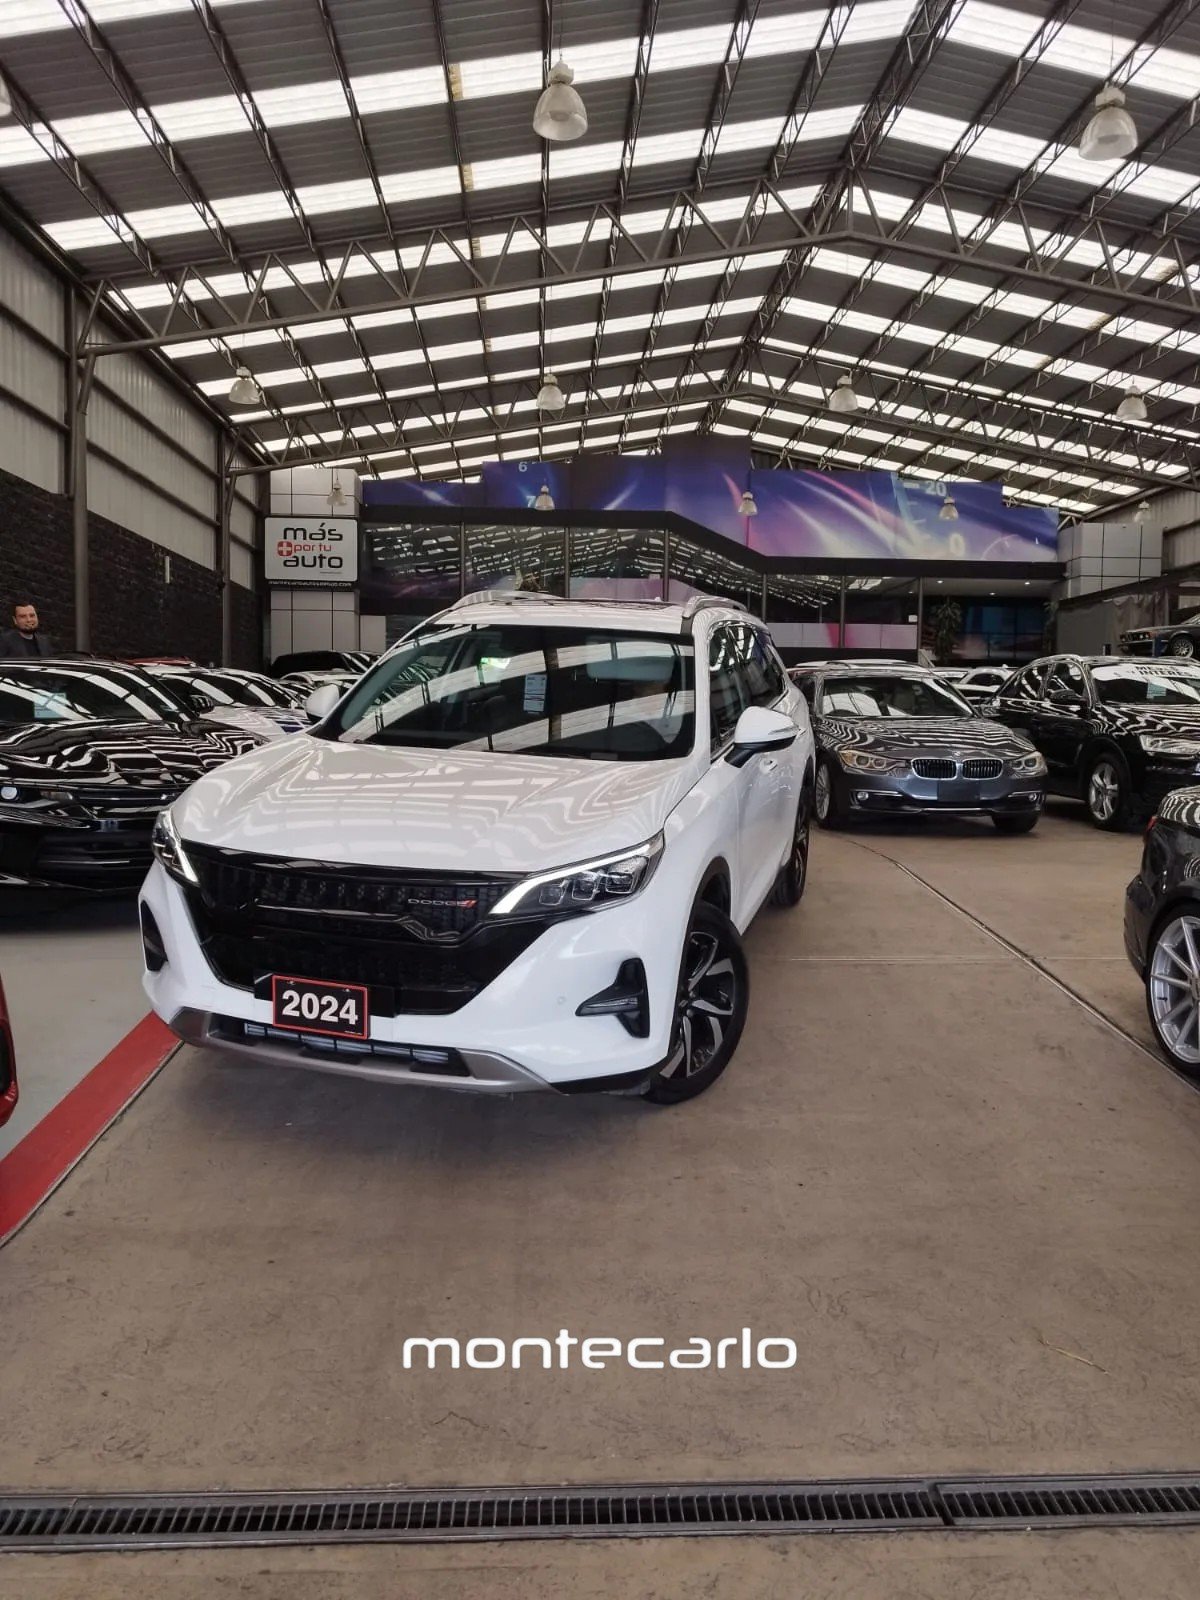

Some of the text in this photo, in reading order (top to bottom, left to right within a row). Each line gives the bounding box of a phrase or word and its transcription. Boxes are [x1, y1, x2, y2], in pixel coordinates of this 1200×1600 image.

[518, 461, 528, 472] 6
[925, 481, 947, 497] 20
[283, 522, 343, 541] más
[283, 554, 343, 569] auto
[407, 898, 468, 907] DODGE
[281, 989, 358, 1025] 2024
